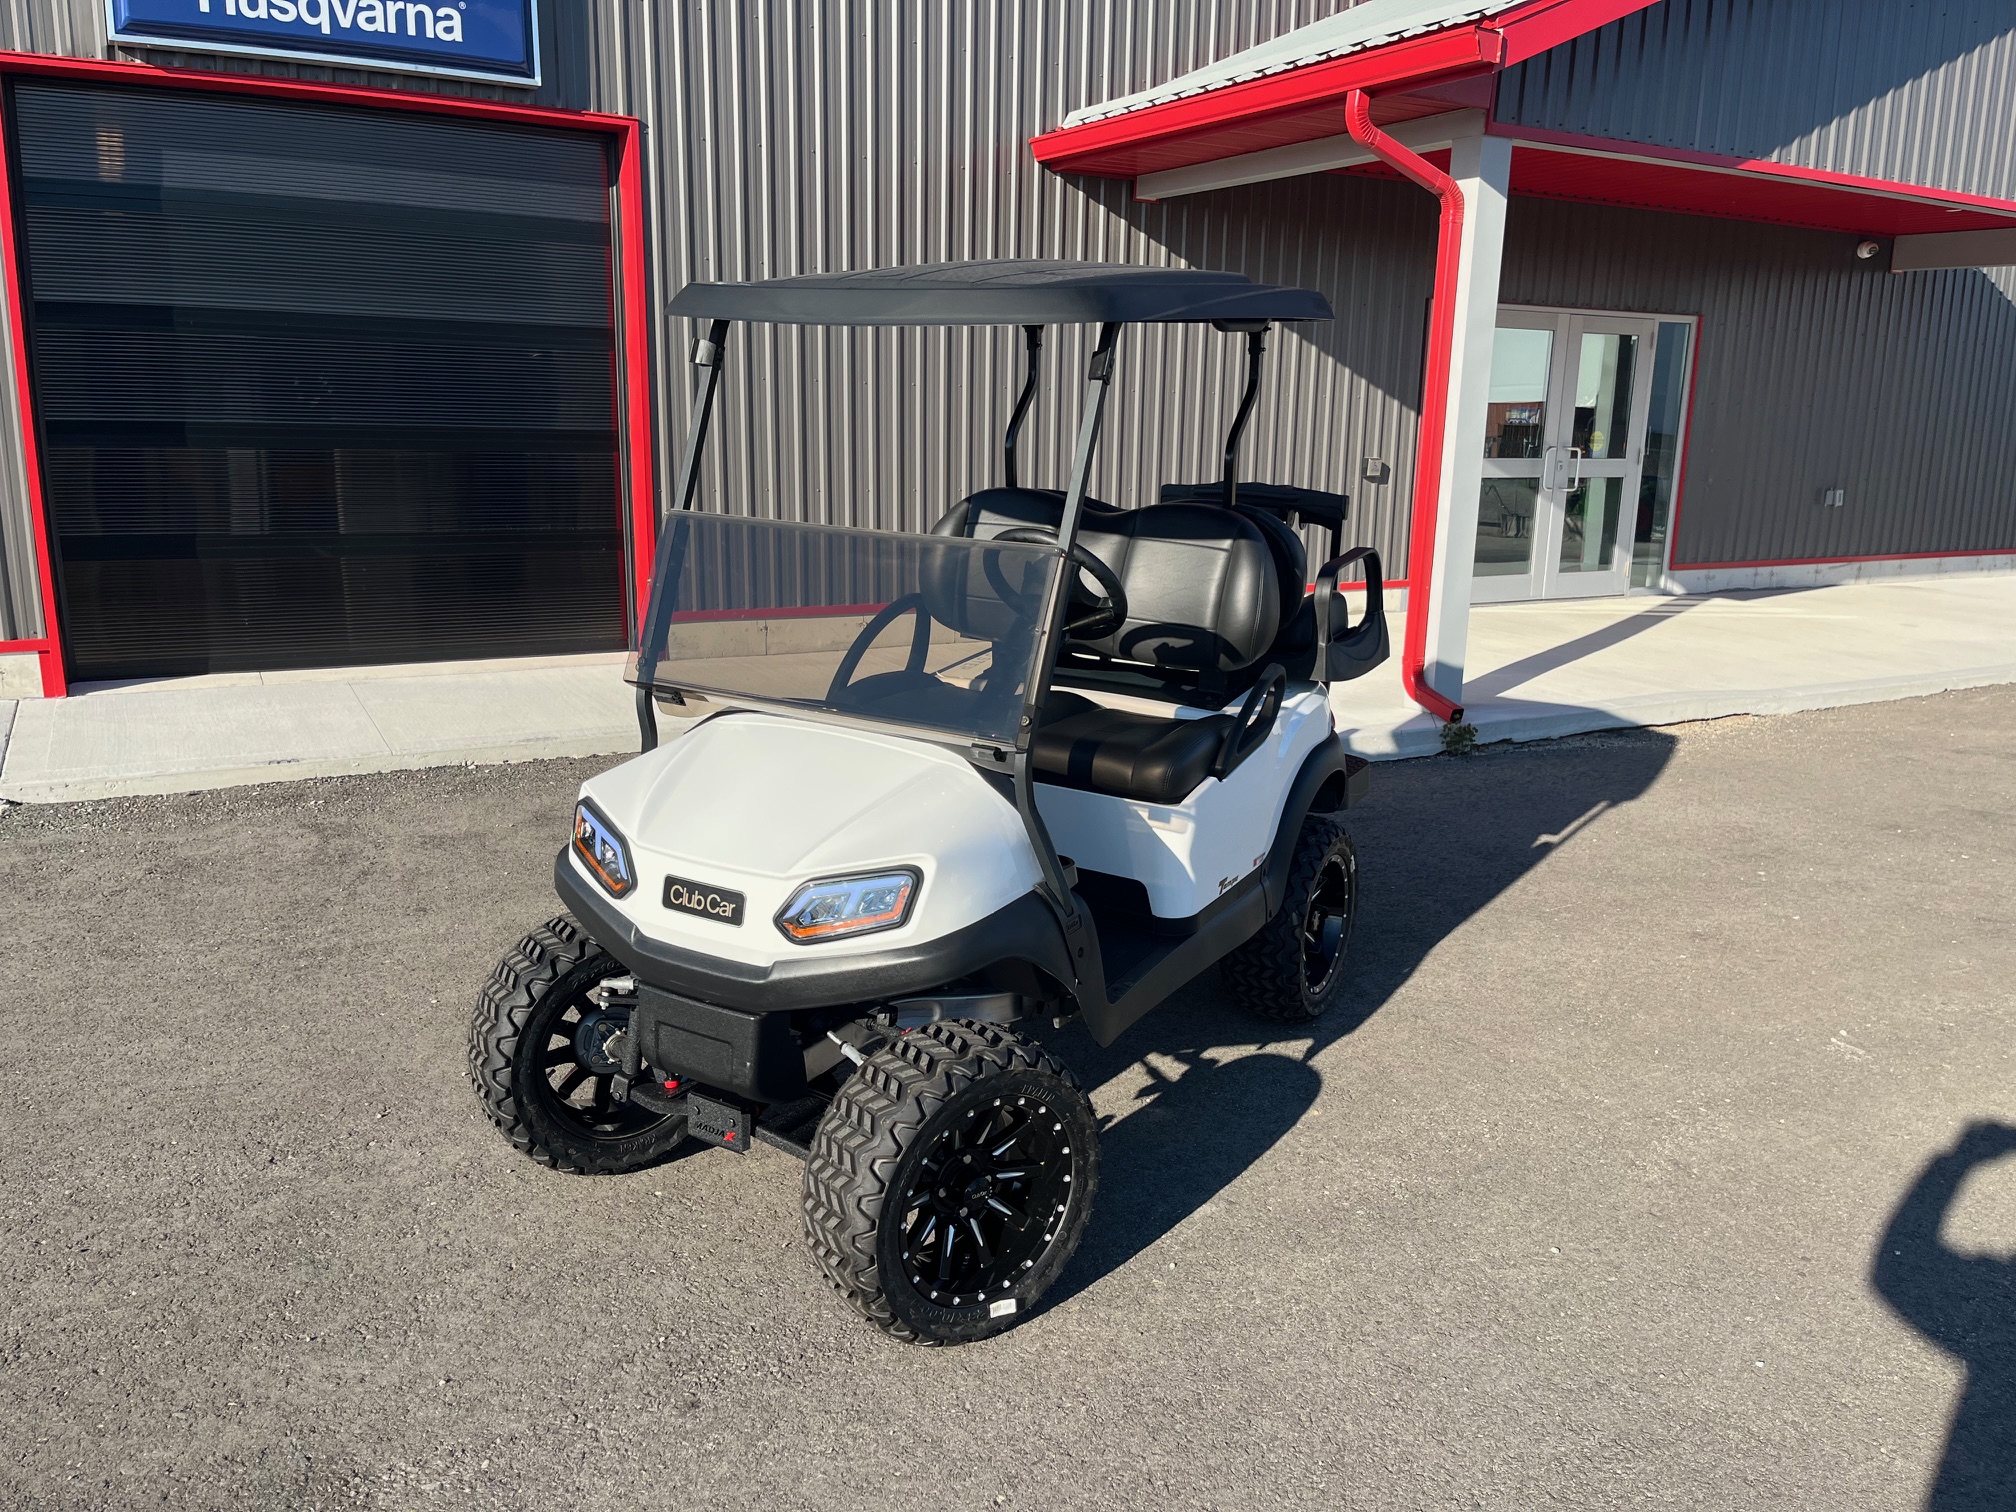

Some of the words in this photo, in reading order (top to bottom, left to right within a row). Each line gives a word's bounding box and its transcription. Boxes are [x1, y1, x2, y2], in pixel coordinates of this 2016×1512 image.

[670, 885, 705, 910] Club
[706, 894, 736, 917] Car
[697, 1122, 736, 1142] MADJAX
